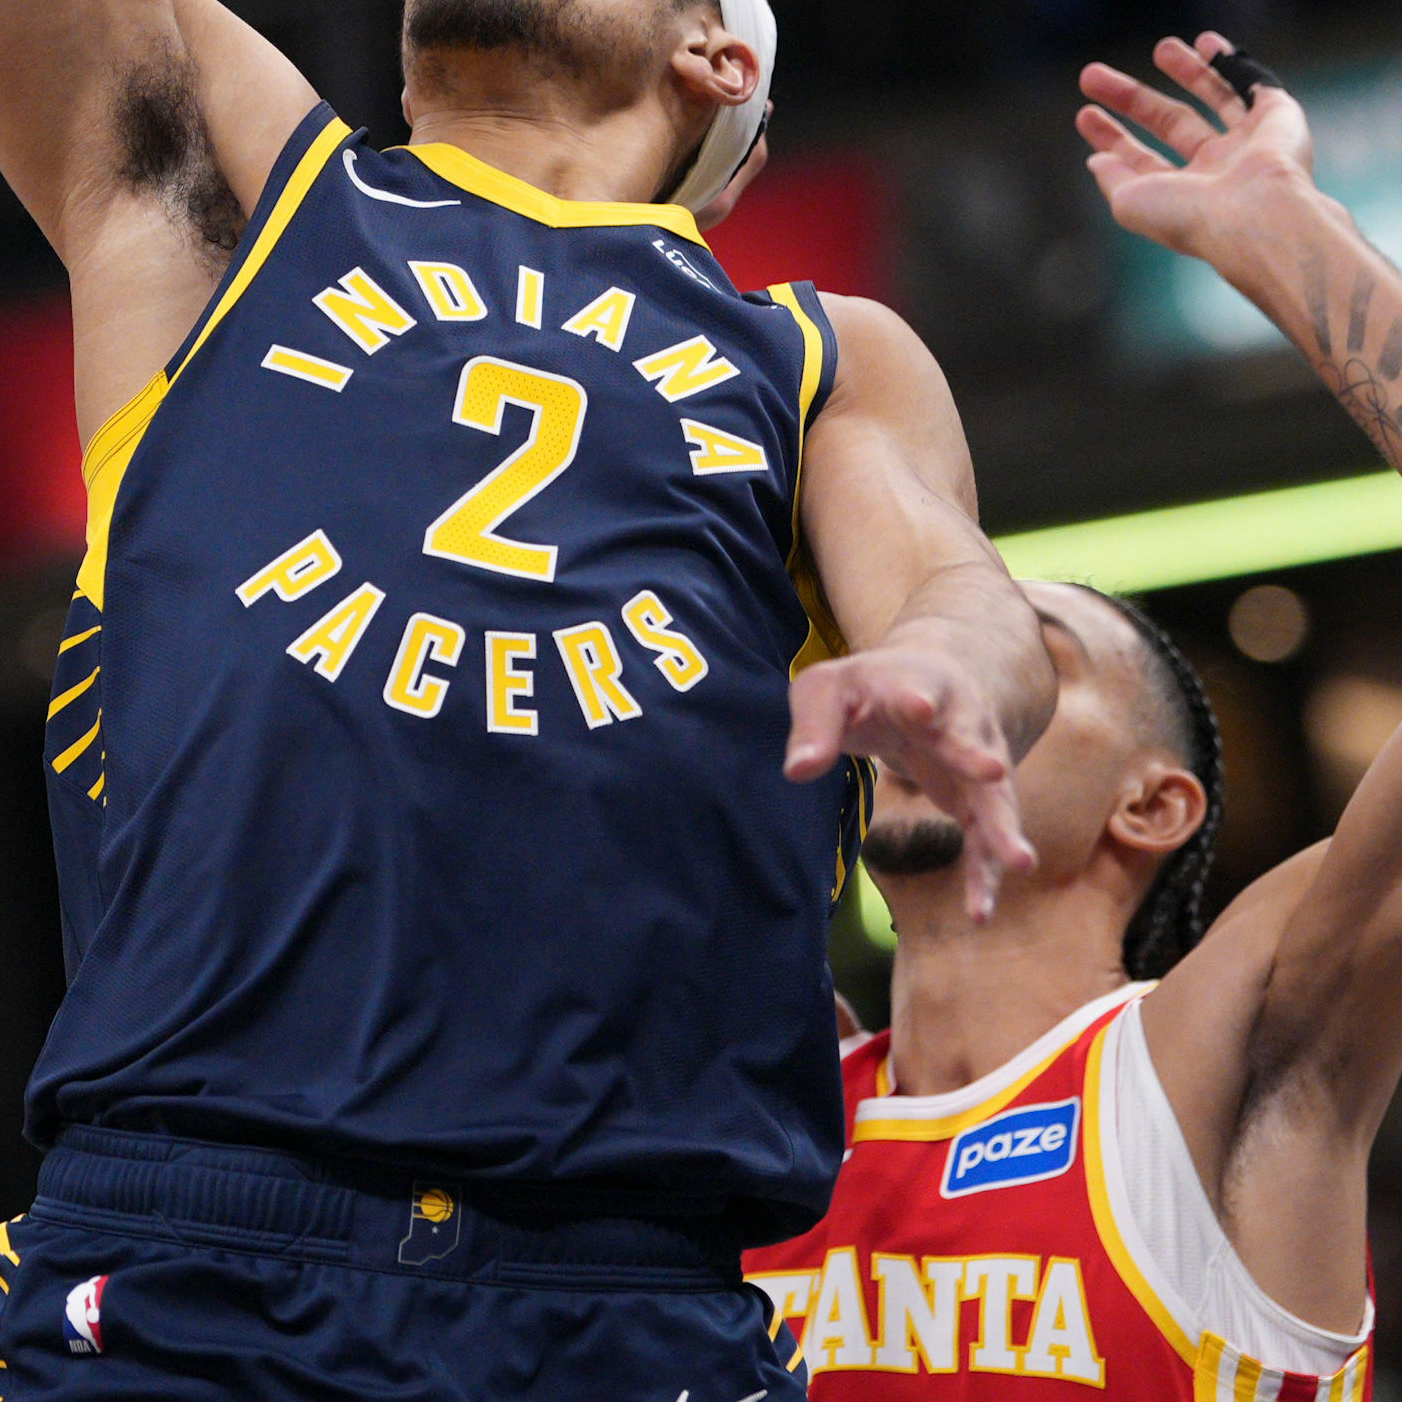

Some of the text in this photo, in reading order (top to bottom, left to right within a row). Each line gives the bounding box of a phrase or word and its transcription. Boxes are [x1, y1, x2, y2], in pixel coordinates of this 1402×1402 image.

[260, 260, 769, 476] INDIANA
[422, 354, 588, 583] 2
[235, 528, 709, 736] PACERS
[956, 1123, 1068, 1179] paze
[69, 1339, 92, 1353] NBA
